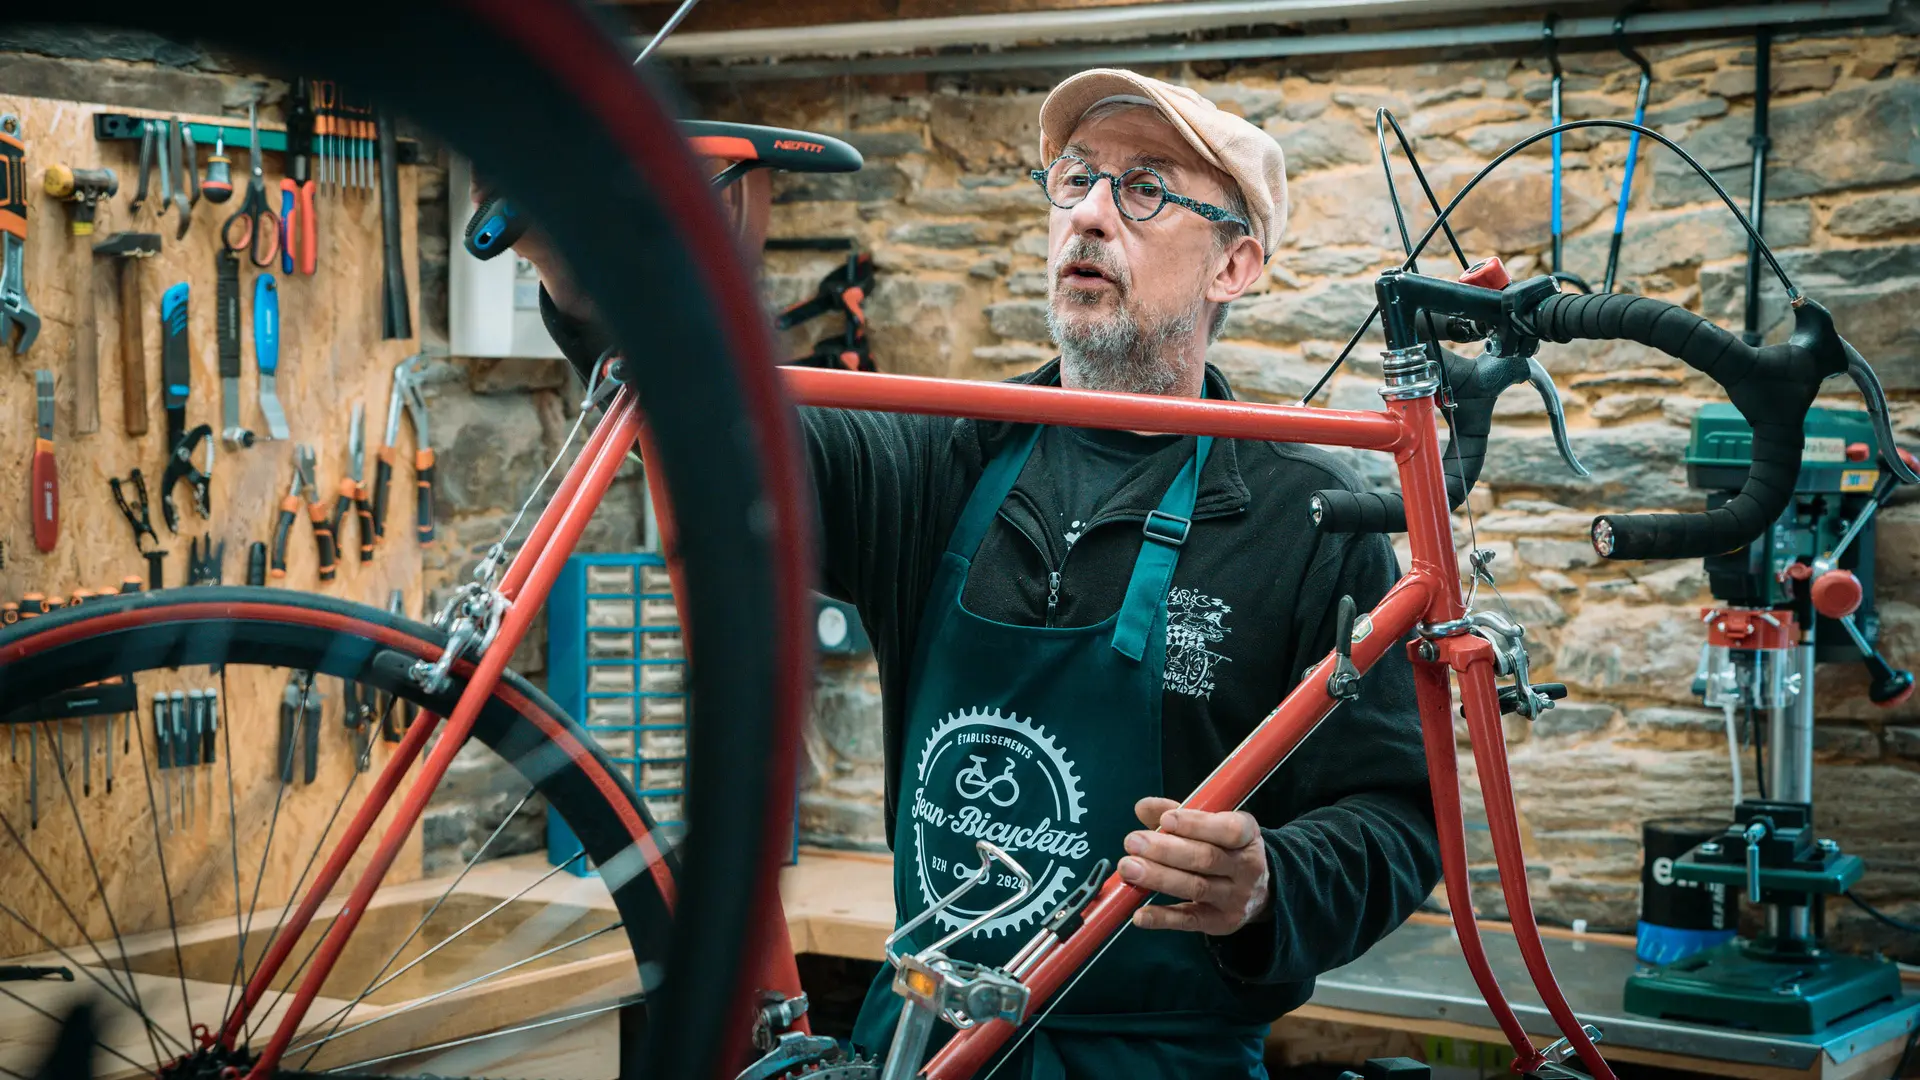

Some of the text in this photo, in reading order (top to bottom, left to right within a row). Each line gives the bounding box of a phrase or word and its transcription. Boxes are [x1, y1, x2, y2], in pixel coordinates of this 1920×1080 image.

[957, 733, 1033, 759] ÉTABLISSEMENTS
[911, 787, 1091, 860] Jean-Bicyclette
[932, 855, 947, 873] BZH
[996, 873, 1025, 891] 2024
